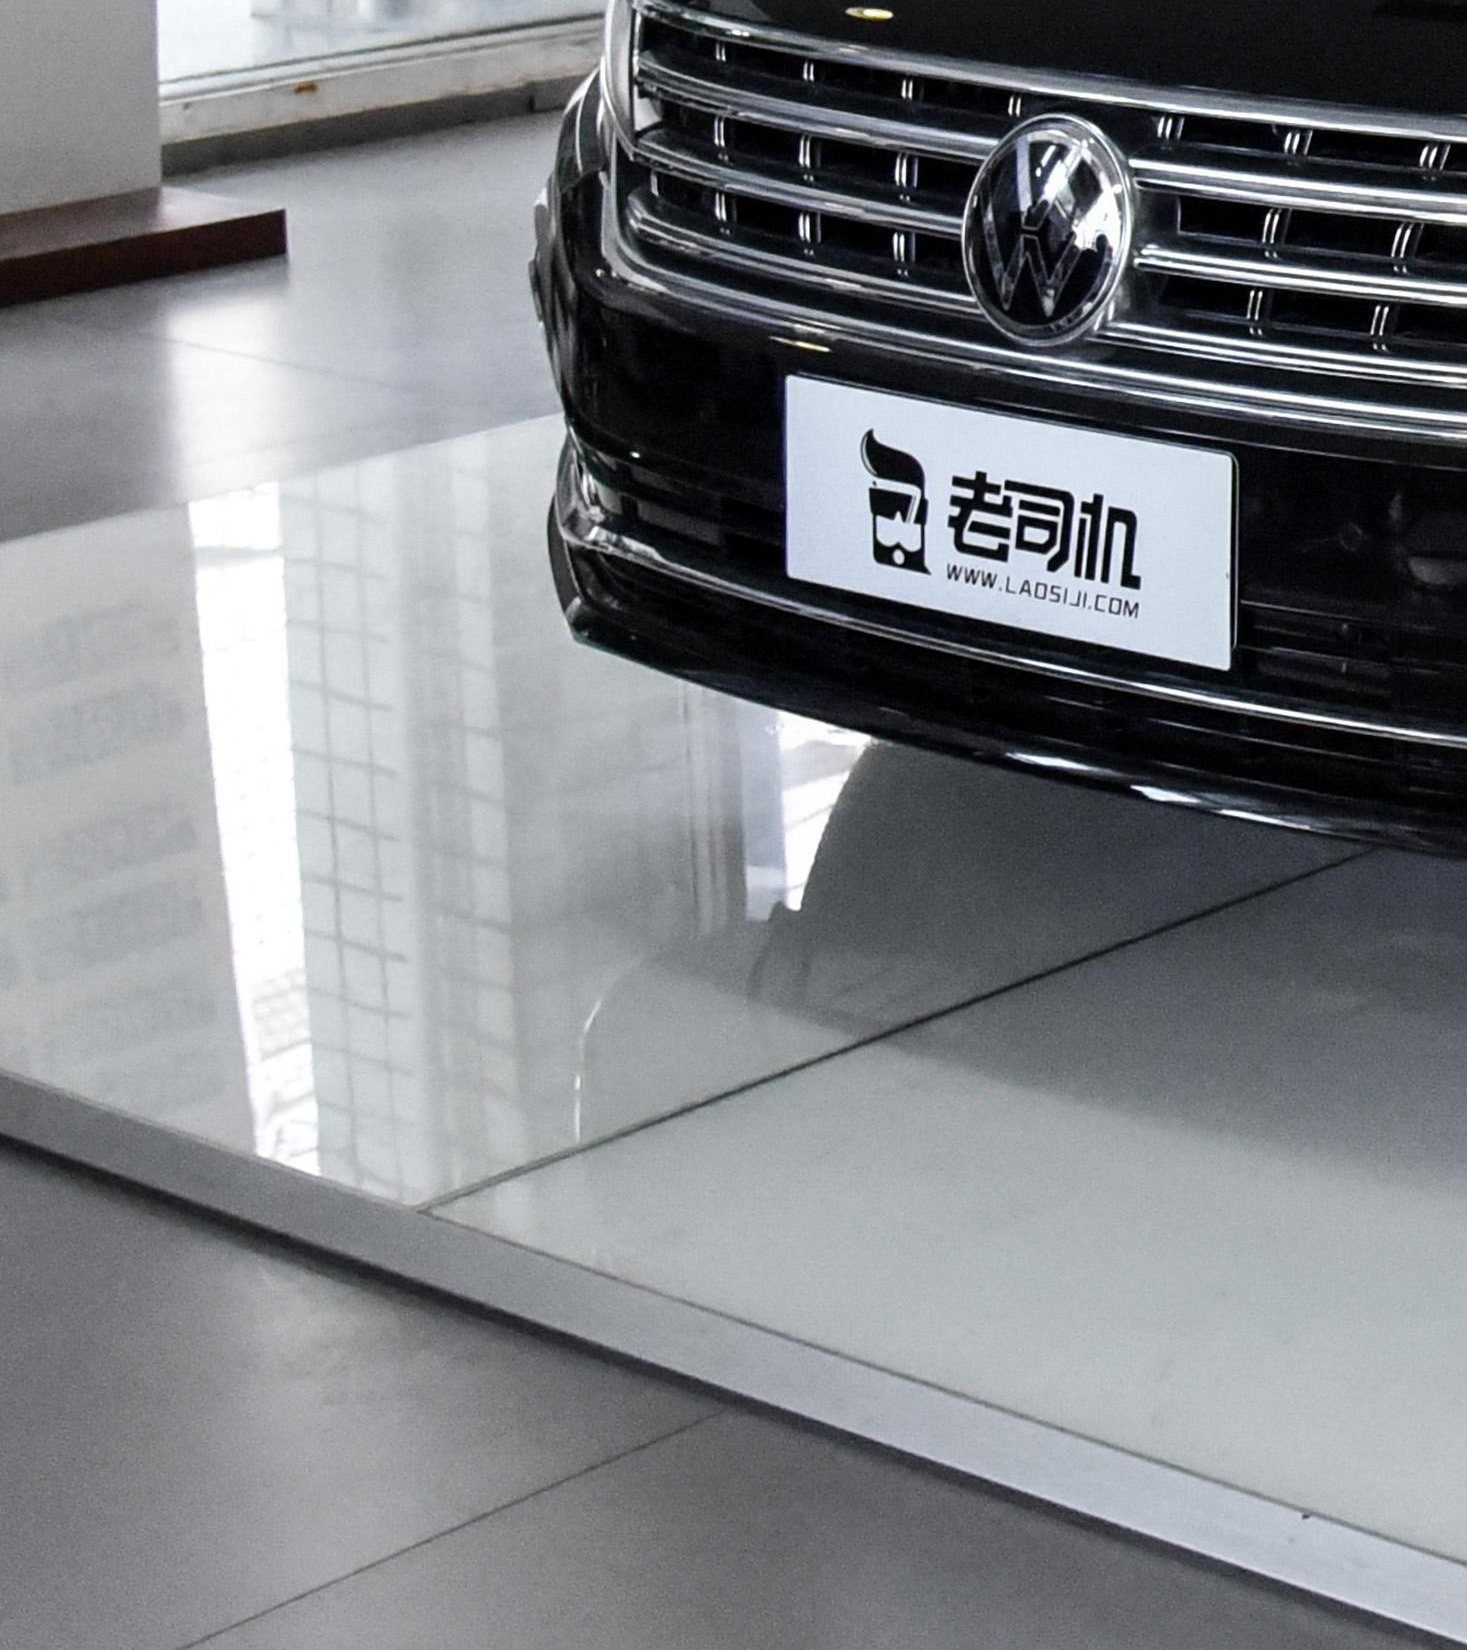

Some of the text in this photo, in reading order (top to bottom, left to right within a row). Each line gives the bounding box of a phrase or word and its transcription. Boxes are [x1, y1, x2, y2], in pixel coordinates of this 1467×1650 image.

[947, 470, 1141, 591] 老司机
[946, 563, 1140, 620] WWW.LAOSIJI.COM
